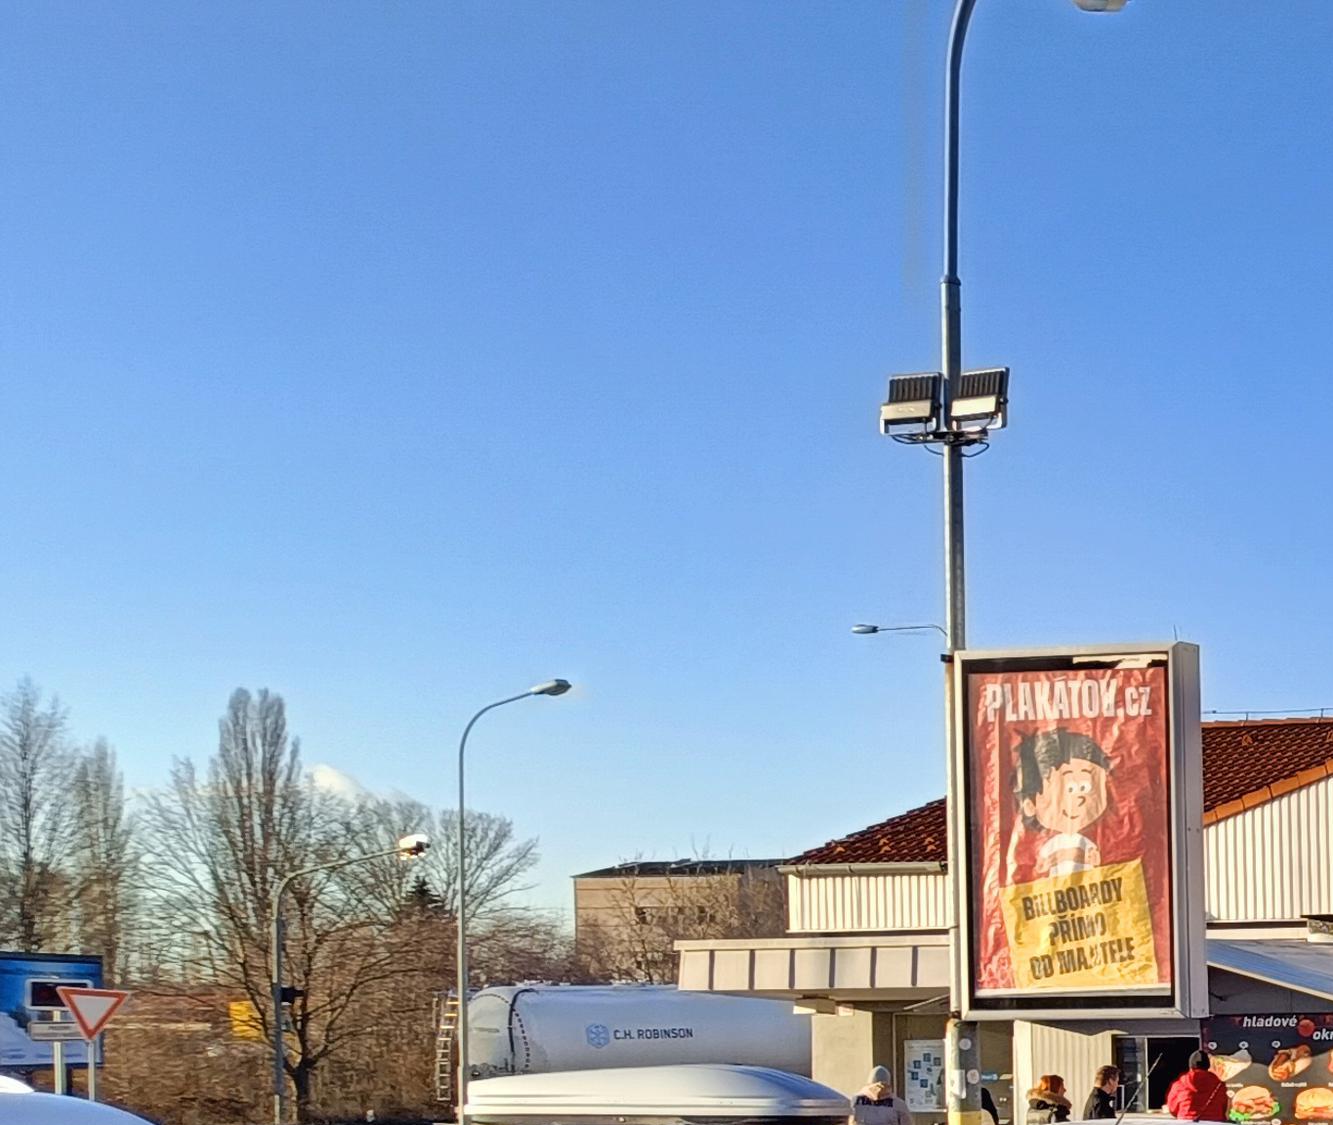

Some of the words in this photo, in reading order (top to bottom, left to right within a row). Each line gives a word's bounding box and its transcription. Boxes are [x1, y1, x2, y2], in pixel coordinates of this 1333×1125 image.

[1029, 954, 1055, 980] OD
[1242, 1015, 1298, 1028] hladové
[613, 1029, 635, 1040] C.H.
[637, 1028, 693, 1040] ROBINSON
